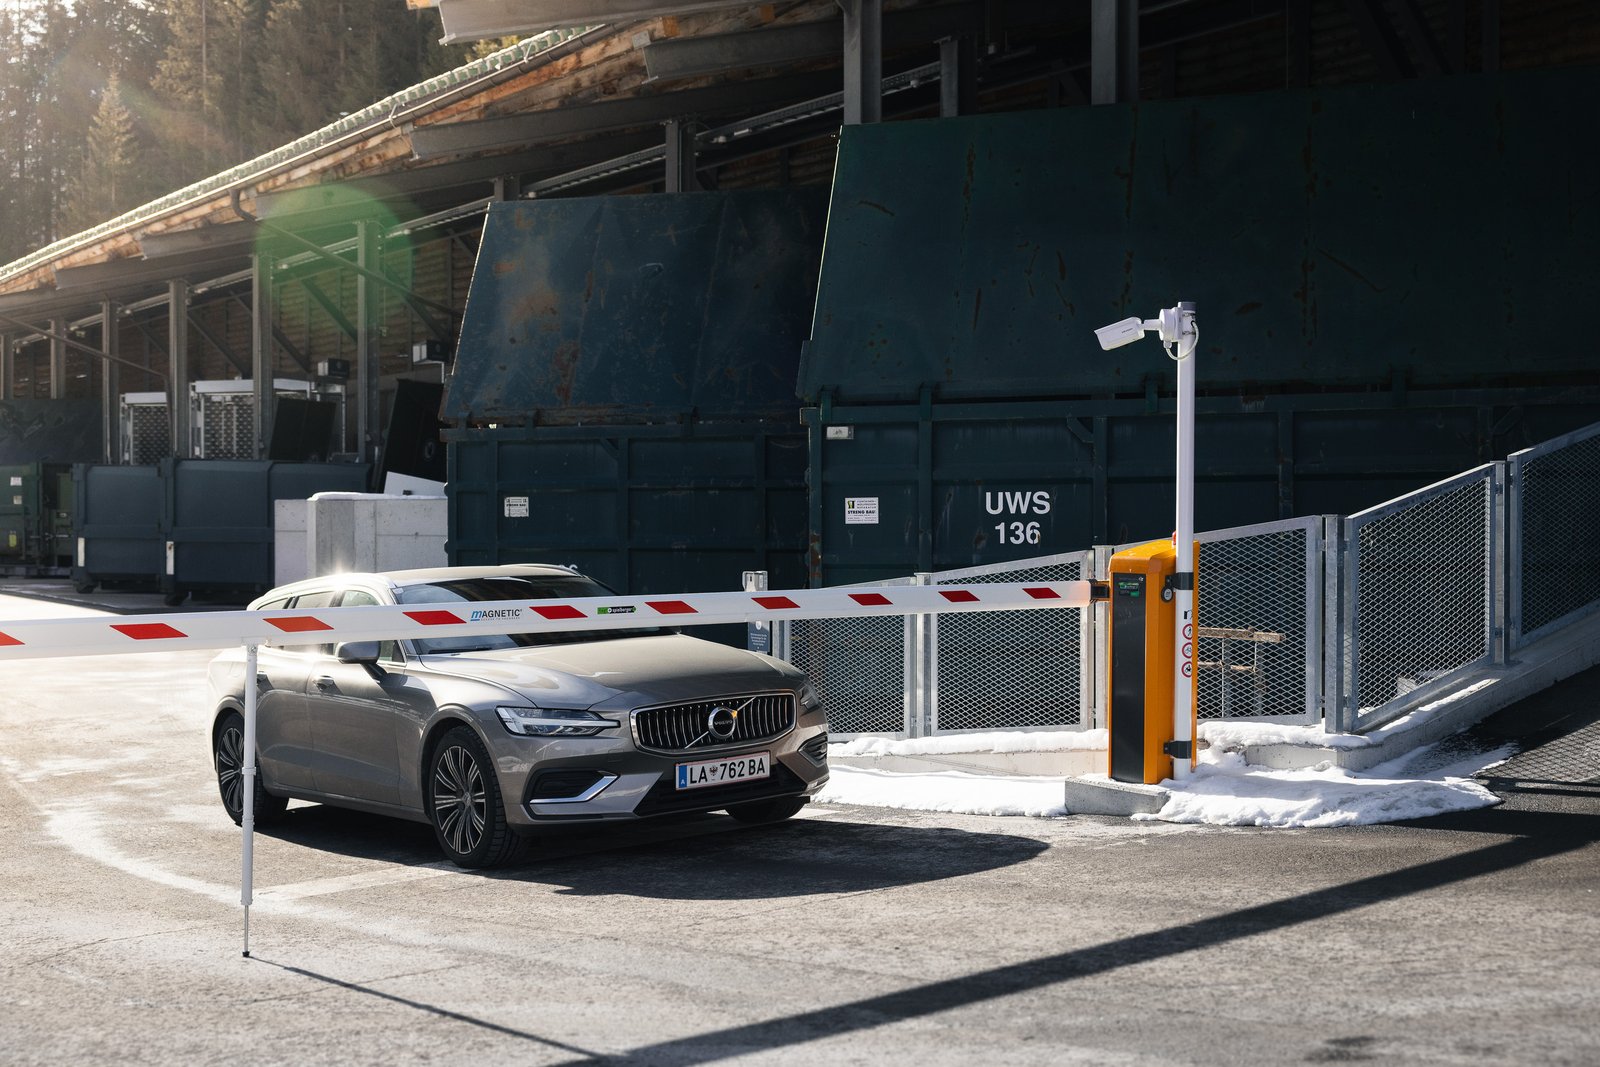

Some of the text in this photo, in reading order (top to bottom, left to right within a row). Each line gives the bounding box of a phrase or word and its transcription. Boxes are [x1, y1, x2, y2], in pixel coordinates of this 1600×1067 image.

[986, 491, 1051, 515] UWS
[995, 521, 1041, 545] 136
[690, 757, 765, 784] LA 762 BA
